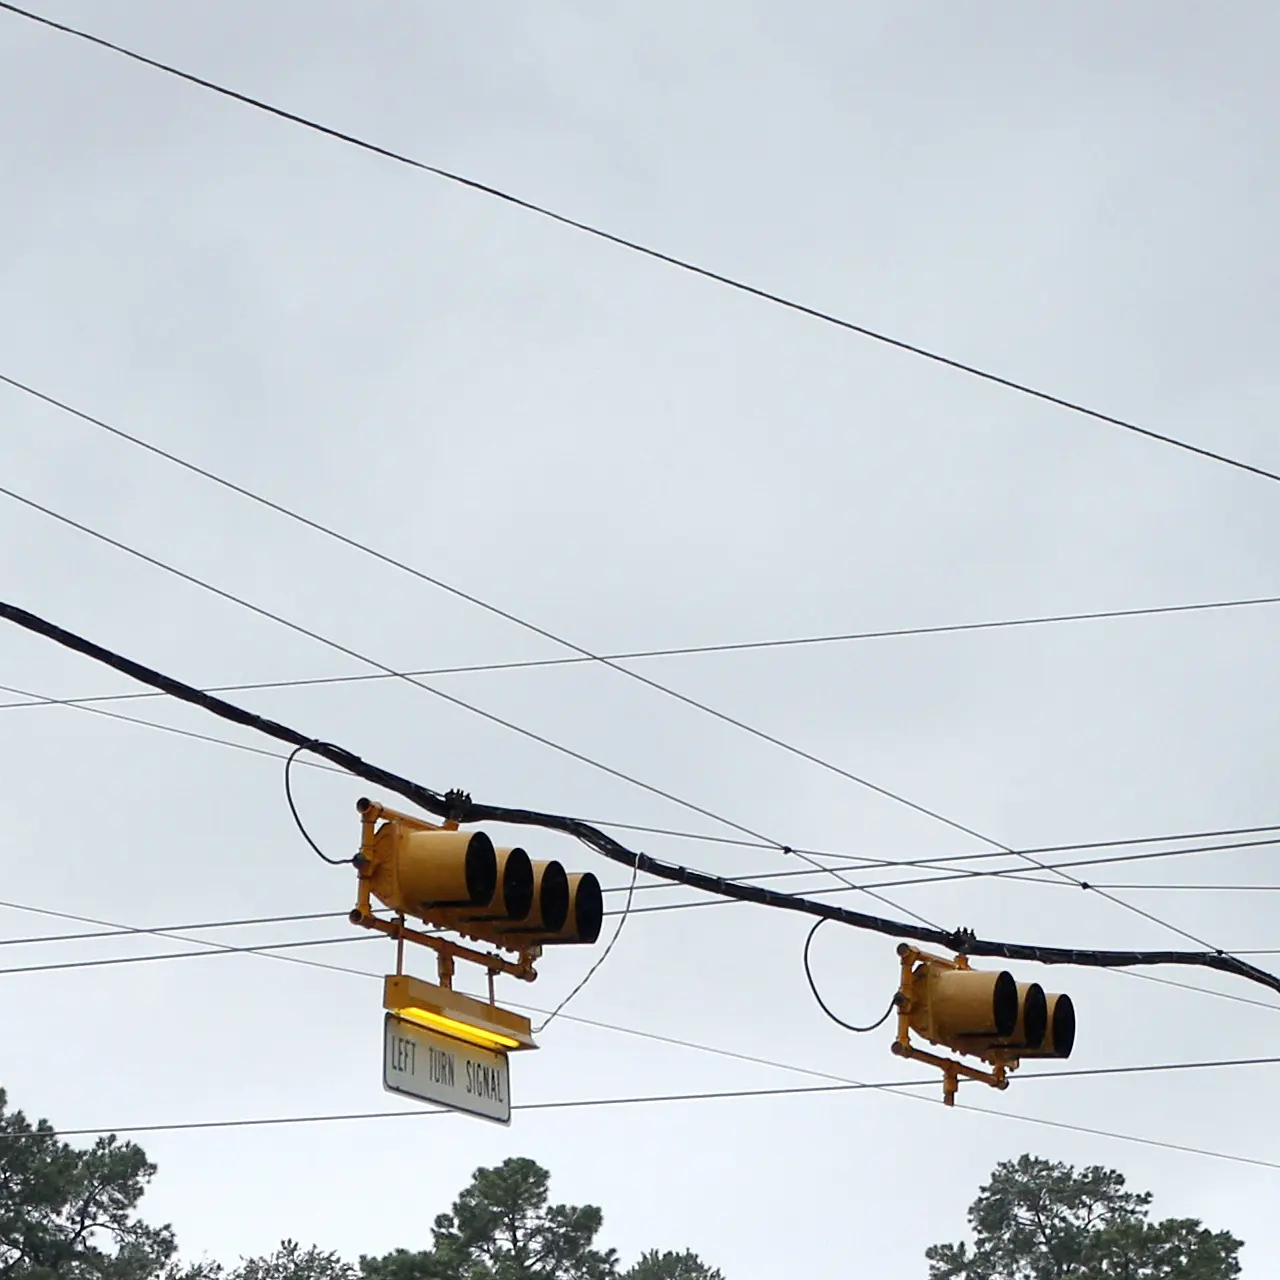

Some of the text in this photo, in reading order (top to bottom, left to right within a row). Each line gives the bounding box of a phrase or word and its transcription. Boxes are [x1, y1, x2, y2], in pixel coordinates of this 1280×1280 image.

[392, 1035, 504, 1103] LEFT TURN SIGNAL
